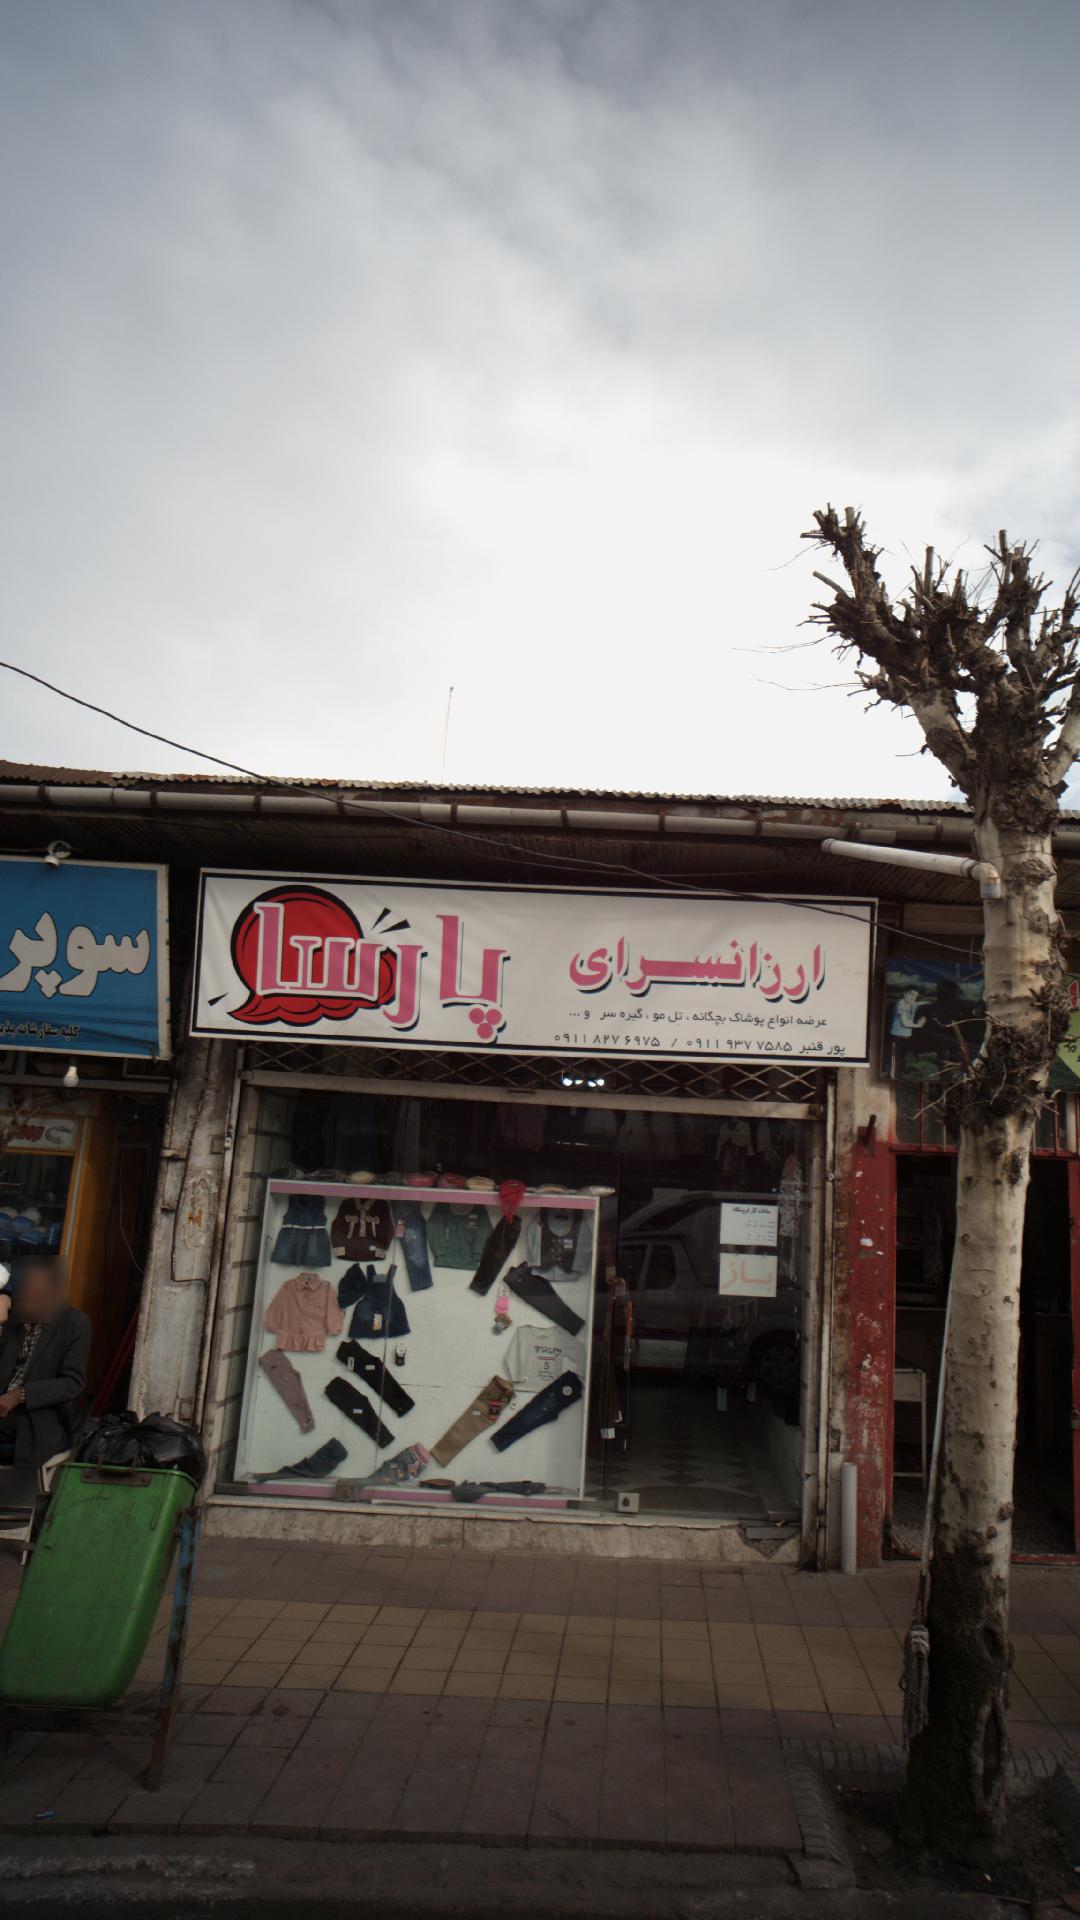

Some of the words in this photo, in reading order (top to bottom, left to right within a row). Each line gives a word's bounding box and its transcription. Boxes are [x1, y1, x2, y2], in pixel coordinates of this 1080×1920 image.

[0, 911, 151, 999] سوپر
[254, 902, 506, 1041] پارسا
[600, 1010, 617, 1021] سر
[619, 1008, 643, 1022] گیره
[729, 1012, 765, 1027] پوشاک
[767, 1014, 794, 1029] انواع
[796, 1014, 828, 1028] عرضه
[799, 1041, 824, 1054] قنبر
[827, 1046, 846, 1058] پور
